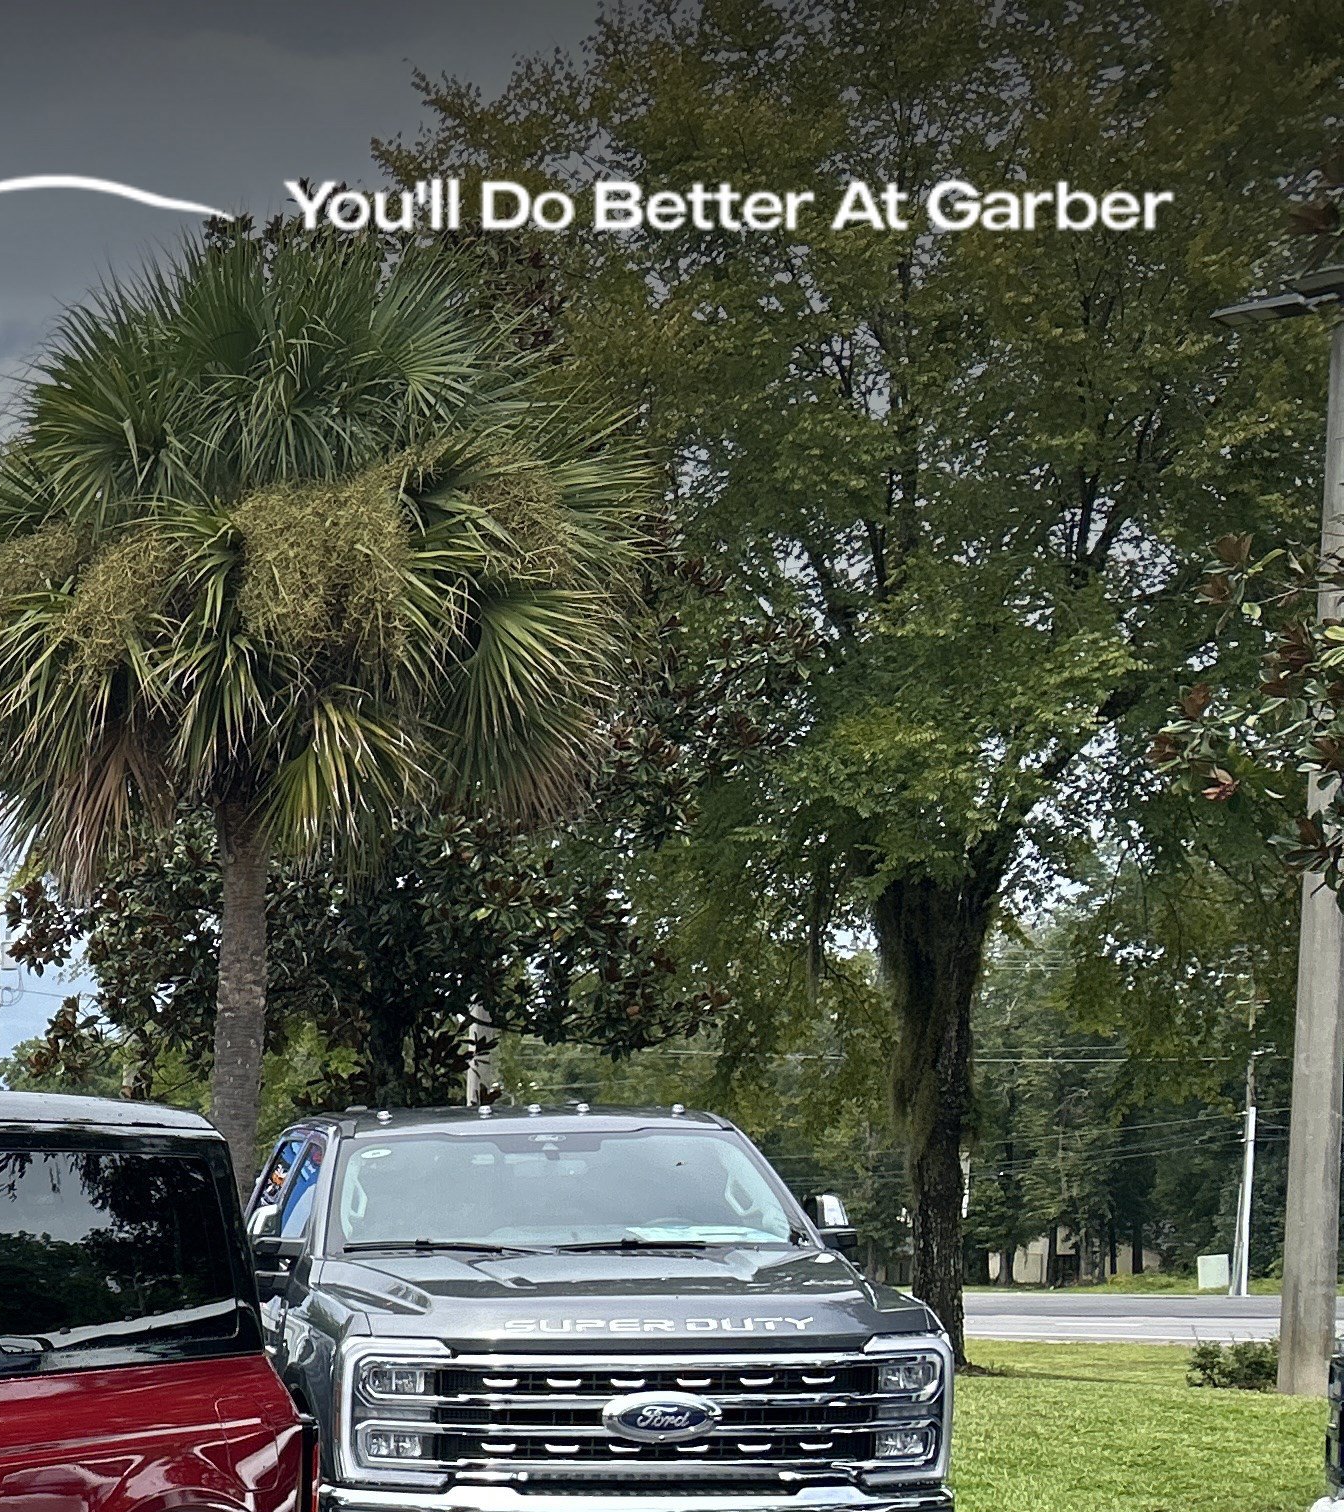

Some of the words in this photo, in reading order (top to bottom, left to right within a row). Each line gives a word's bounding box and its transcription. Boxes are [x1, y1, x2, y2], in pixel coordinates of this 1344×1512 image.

[504, 1318, 676, 1334] SUPER
[685, 1316, 814, 1332] DUTY
[636, 1404, 691, 1428] Ford
